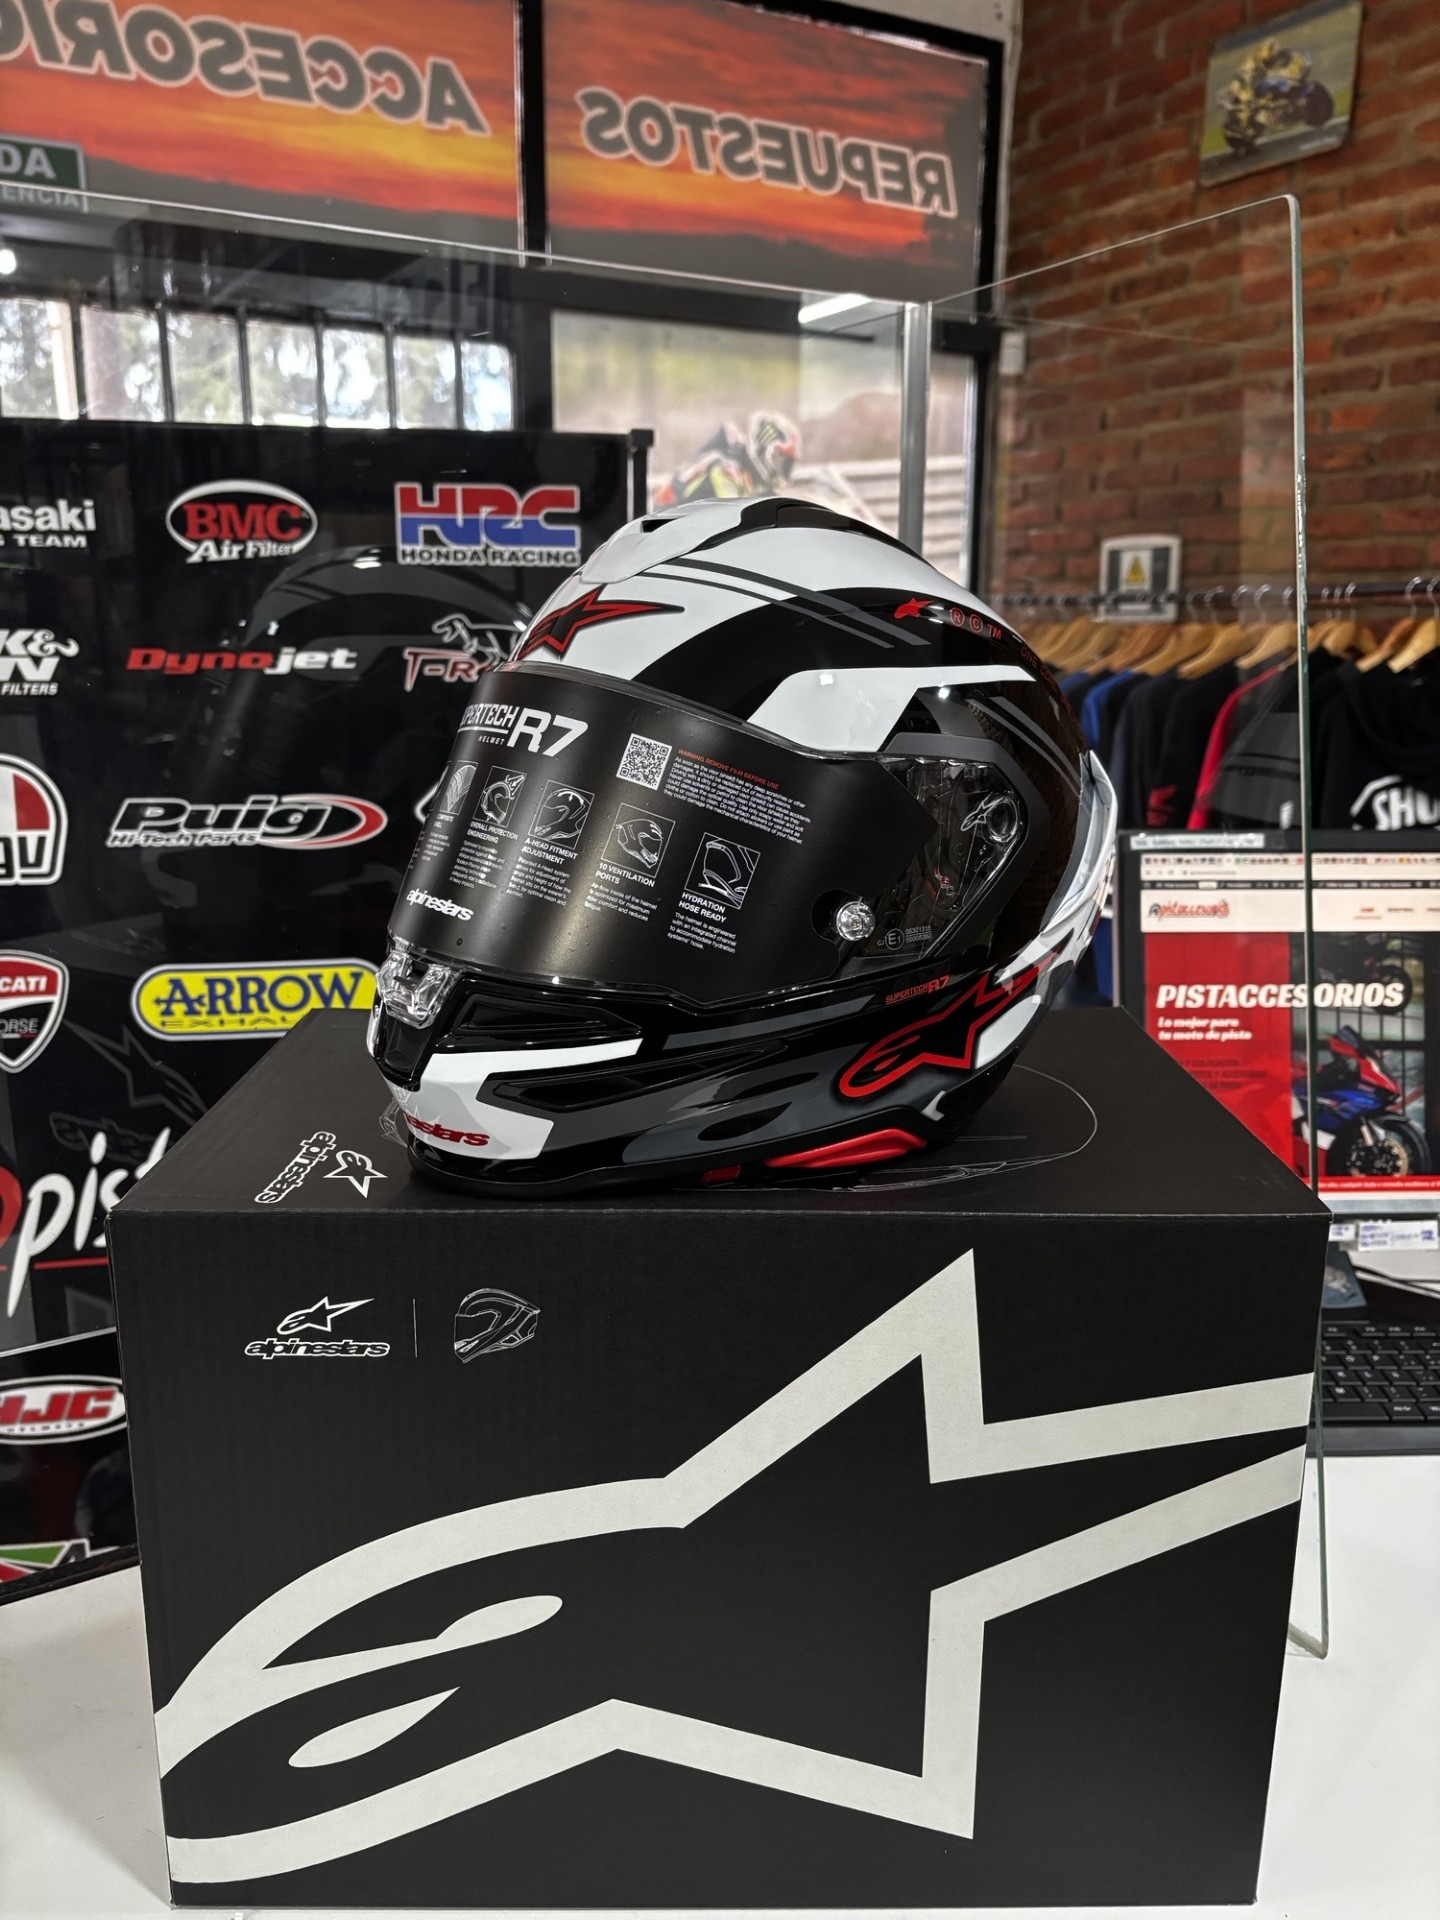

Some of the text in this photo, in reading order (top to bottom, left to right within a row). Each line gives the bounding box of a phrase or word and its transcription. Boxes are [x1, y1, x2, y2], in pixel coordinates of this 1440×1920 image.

[183, 503, 304, 542] BMC
[394, 481, 581, 550] HRC
[13, 534, 88, 549] TEAM
[185, 540, 245, 565] Air
[399, 546, 582, 568] HONDA RACING
[126, 647, 358, 676] Dynojet
[1, 682, 59, 696] FILTERS
[478, 735, 505, 746] HELMET
[507, 707, 589, 757] R7
[766, 780, 780, 790] USE
[110, 795, 333, 843] Puig
[106, 831, 260, 849] Hi-Tech Parts
[524, 837, 578, 859] A-HEAD FITMENT
[521, 845, 564, 864] ADJUSTMENT
[594, 870, 620, 884] PORTS
[597, 861, 655, 887] 10 VENTILATION
[406, 888, 475, 921] alpinestars
[678, 899, 726, 923] HOSE READY
[681, 890, 726, 913] HYDRATION
[154, 971, 365, 1019] ARROW
[927, 975, 950, 993] R7
[1155, 982, 1405, 1009] PISTACCESORIOS
[402, 1111, 490, 1147] estars
[254, 1131, 337, 1204] alpinestars
[244, 1337, 391, 1360] alpinestars
